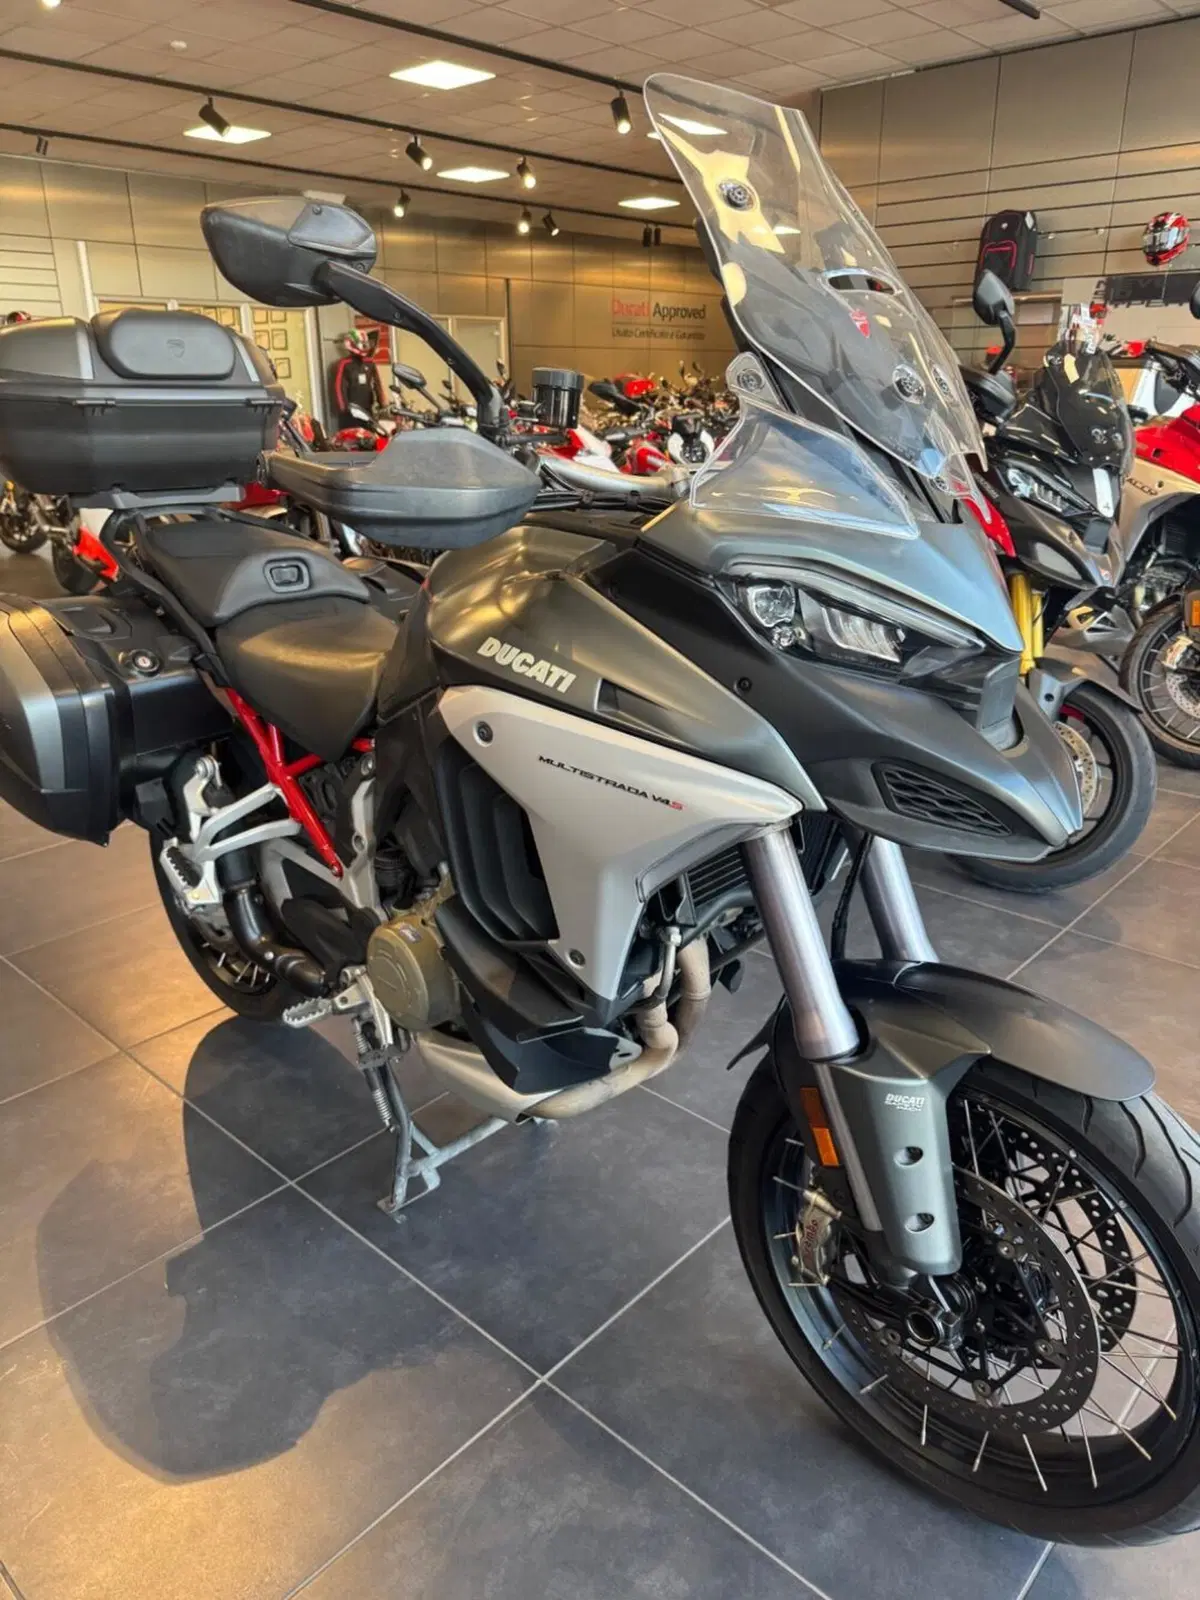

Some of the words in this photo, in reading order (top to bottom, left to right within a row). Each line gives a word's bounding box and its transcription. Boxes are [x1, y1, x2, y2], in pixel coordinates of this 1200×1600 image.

[652, 302, 706, 321] Approved
[477, 636, 577, 694] DUCATI
[538, 755, 648, 799] MULTISTRADA
[885, 1093, 925, 1105] DUCATI
